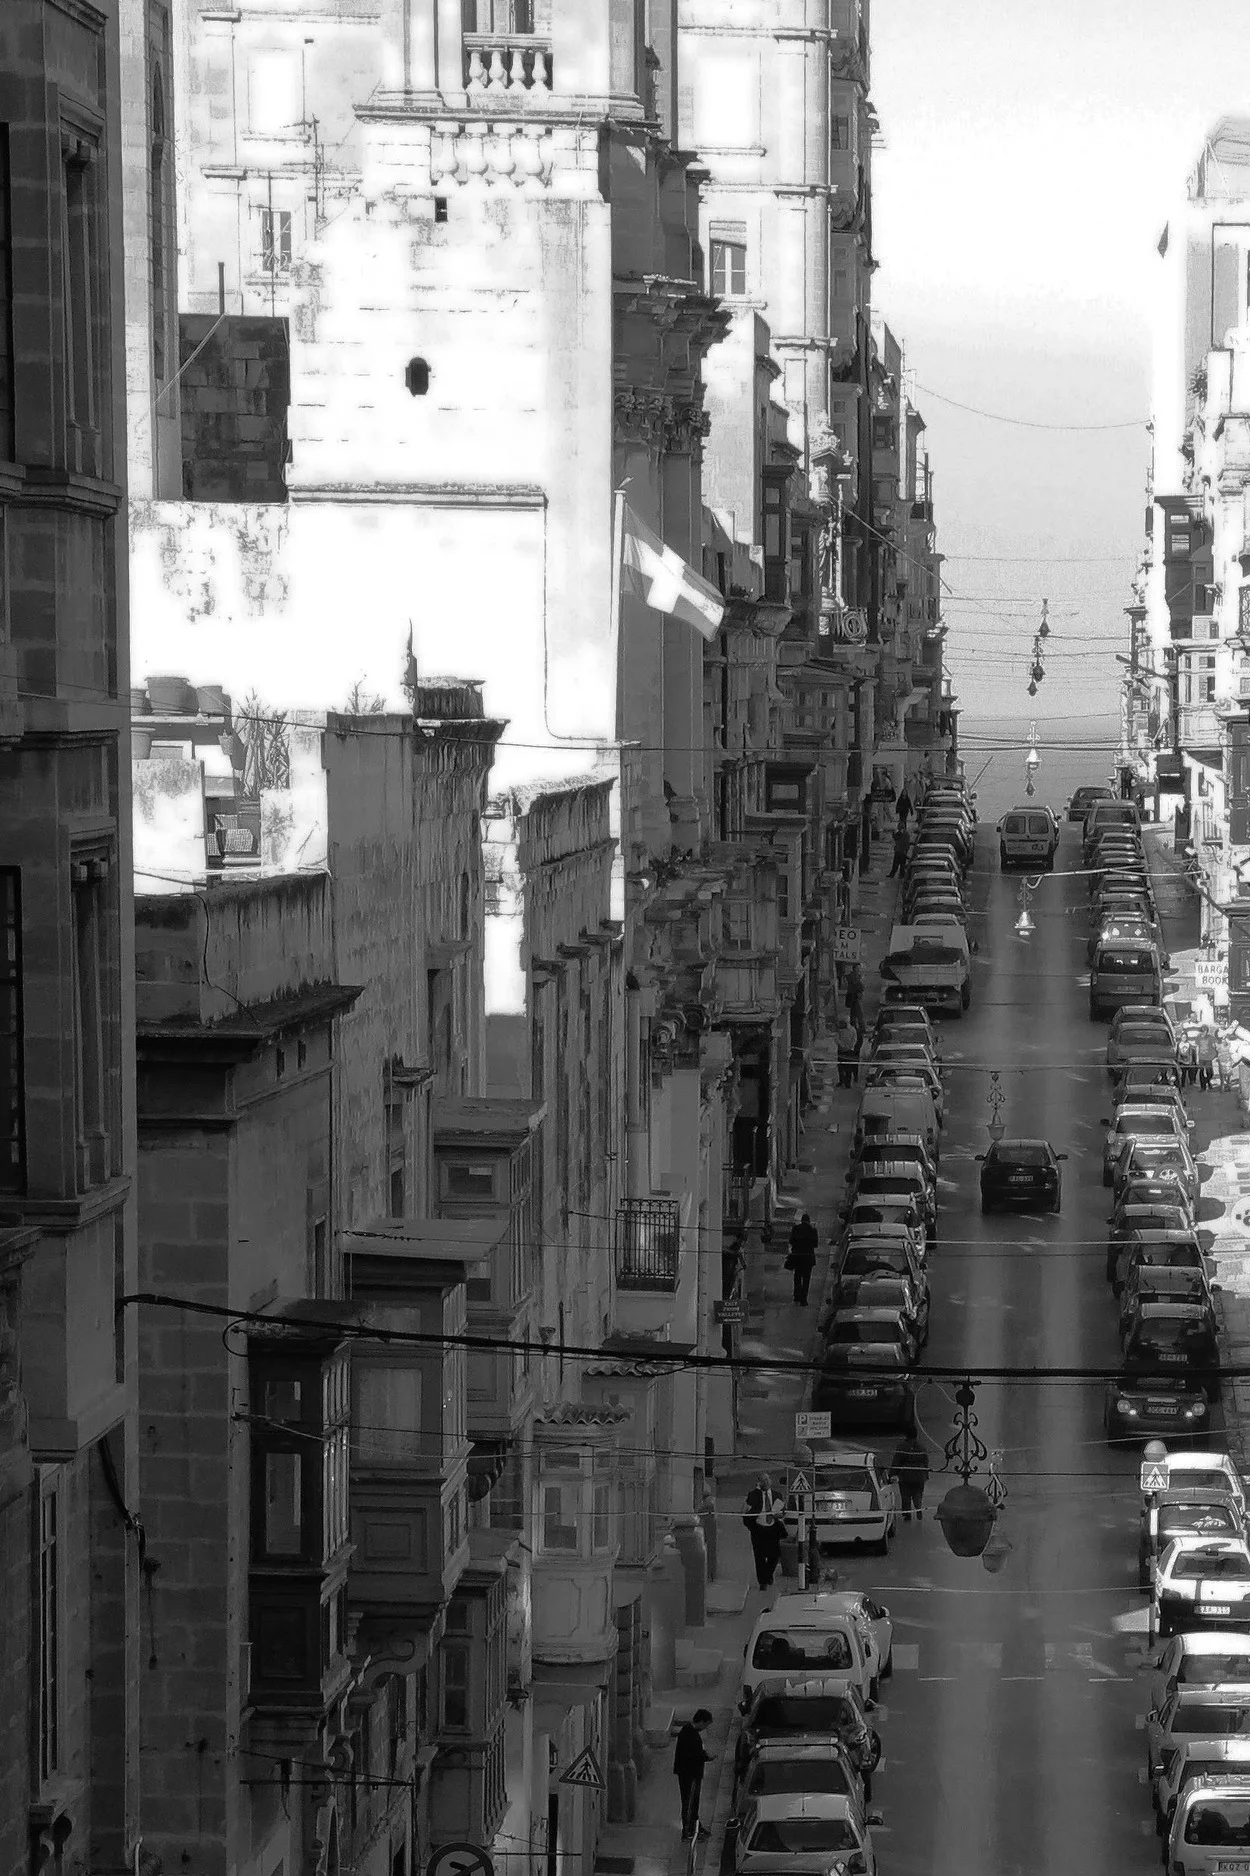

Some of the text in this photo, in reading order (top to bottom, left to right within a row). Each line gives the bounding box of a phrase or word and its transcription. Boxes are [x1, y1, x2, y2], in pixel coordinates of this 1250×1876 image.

[836, 930, 857, 940] EO
[833, 951, 857, 959] TALS
[1198, 965, 1229, 974] BARGA
[1202, 976, 1229, 985] BOOK
